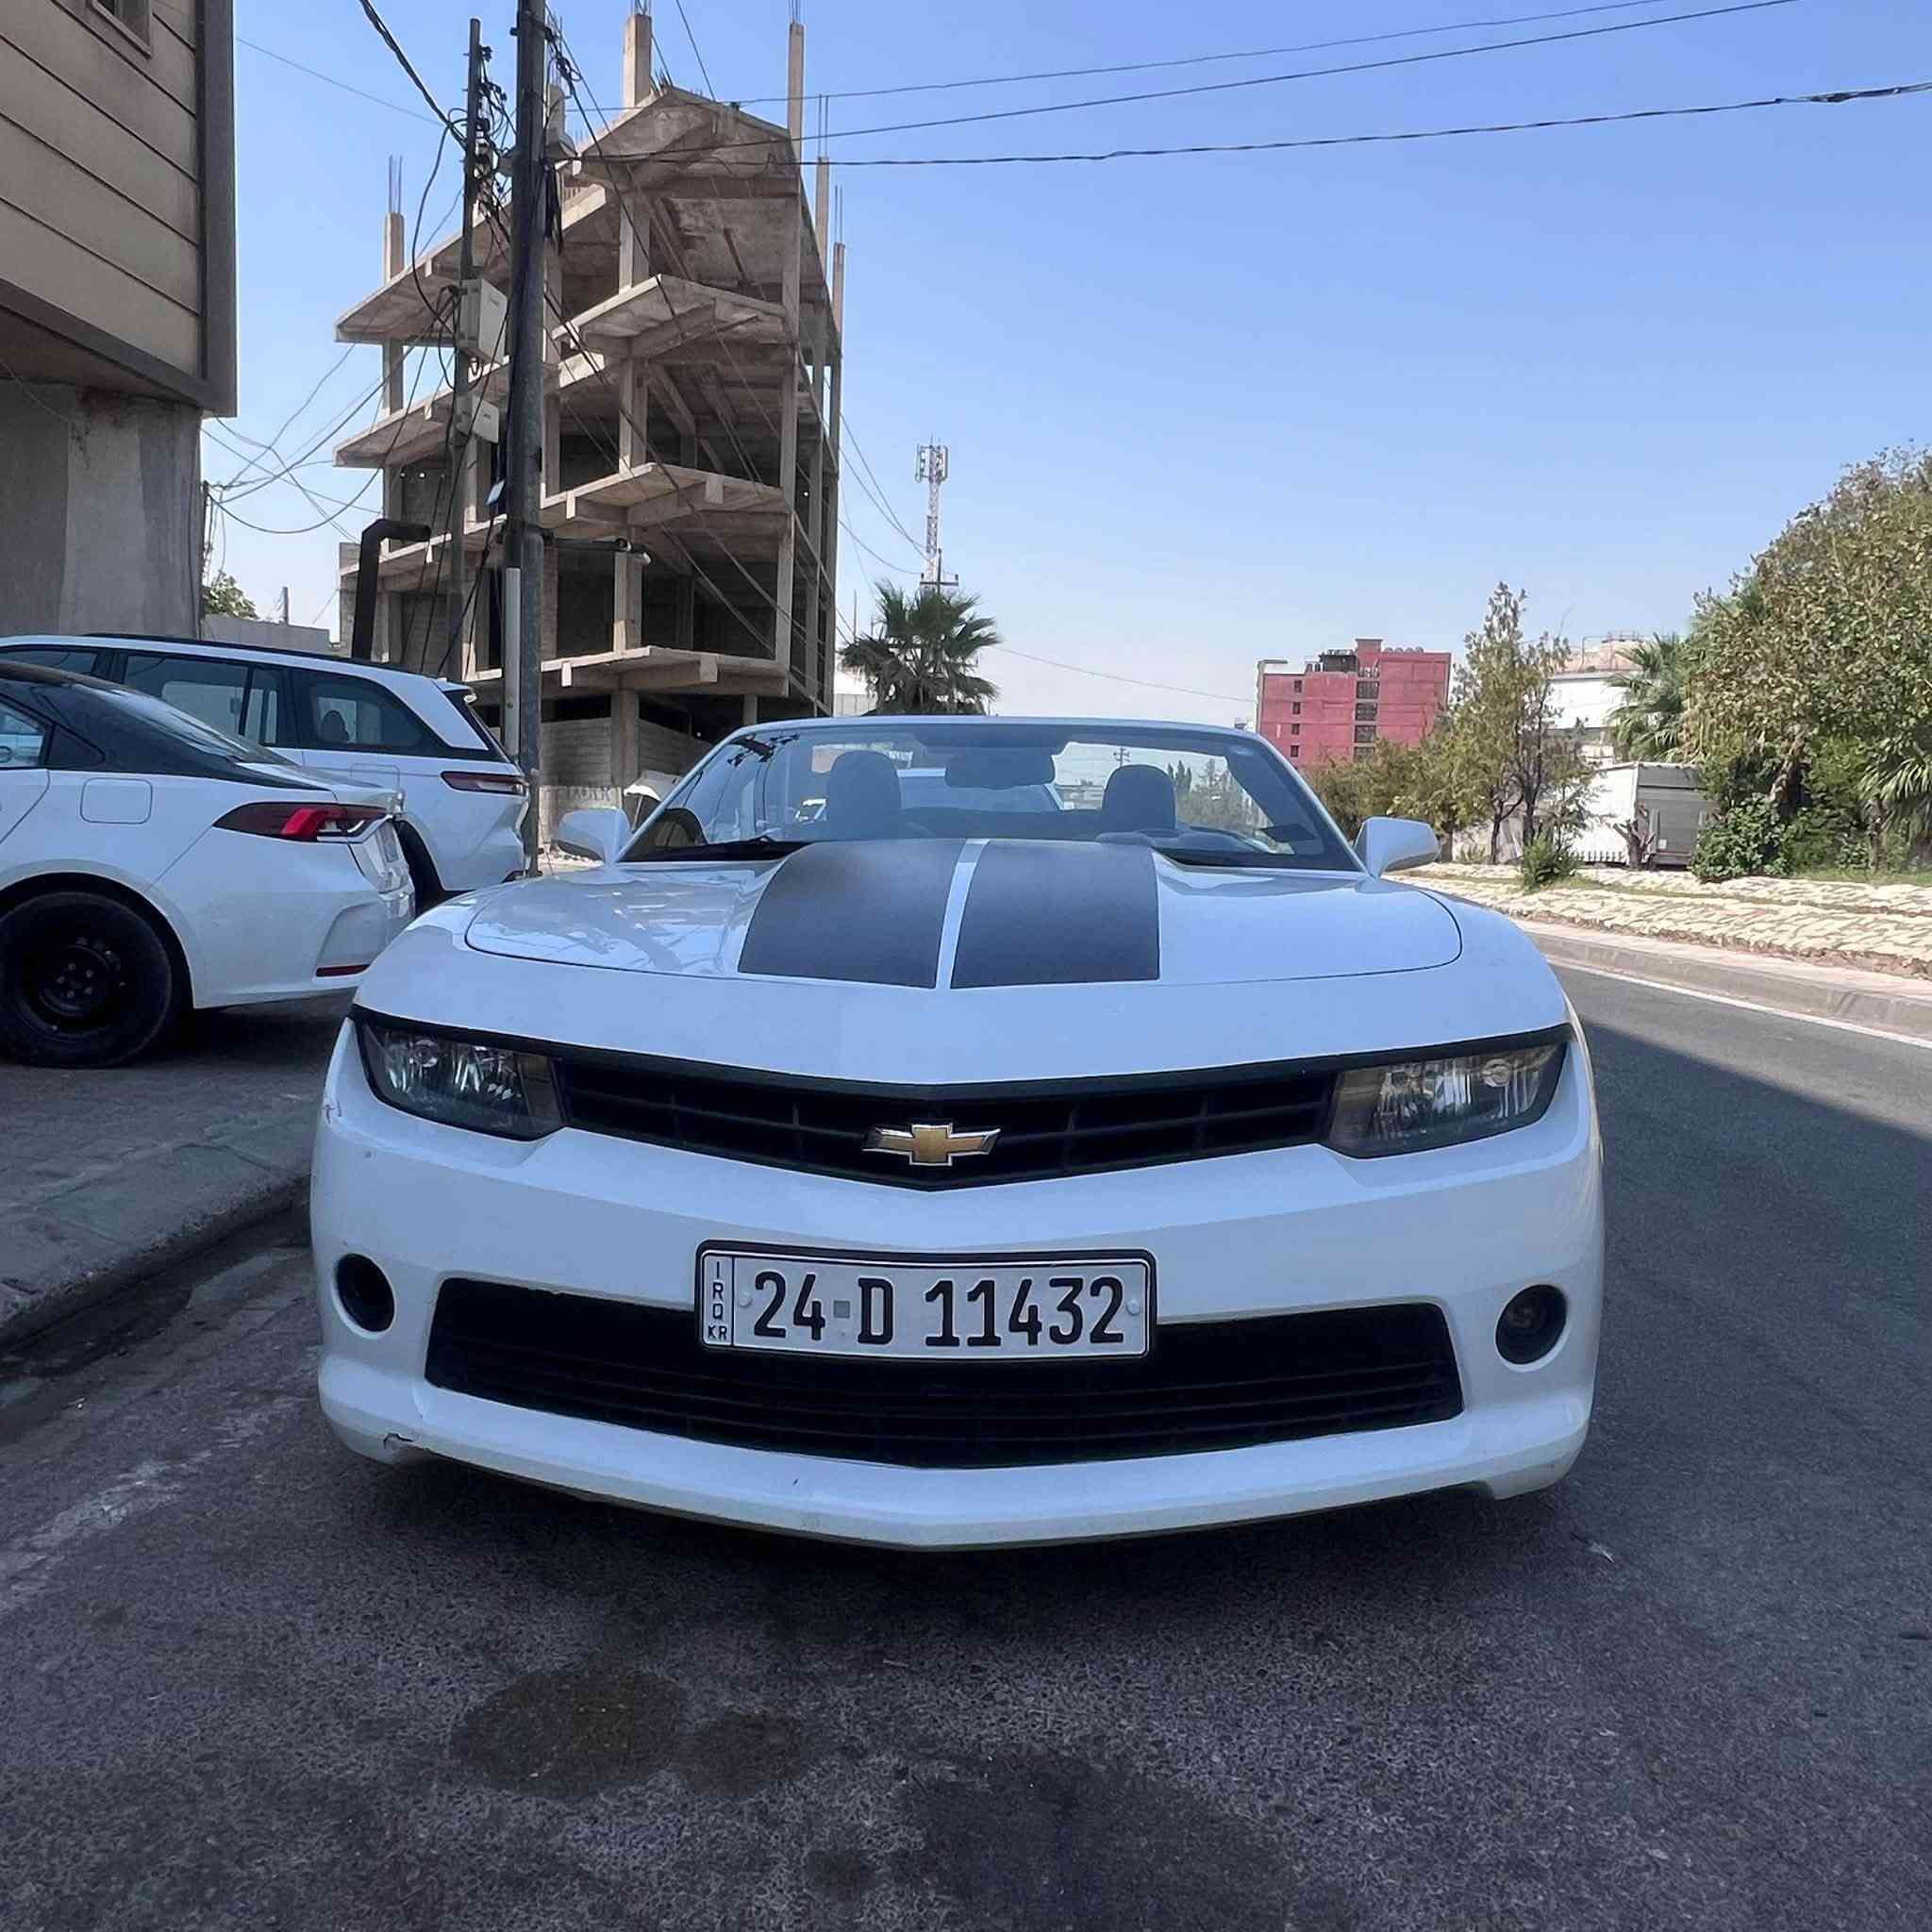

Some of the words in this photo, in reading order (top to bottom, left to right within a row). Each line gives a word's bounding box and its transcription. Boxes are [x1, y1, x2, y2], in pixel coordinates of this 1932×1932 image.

[755, 1271, 826, 1341] 24
[858, 1277, 893, 1344] D
[924, 1275, 1124, 1347] 11432
[708, 1324, 728, 1341] KR
